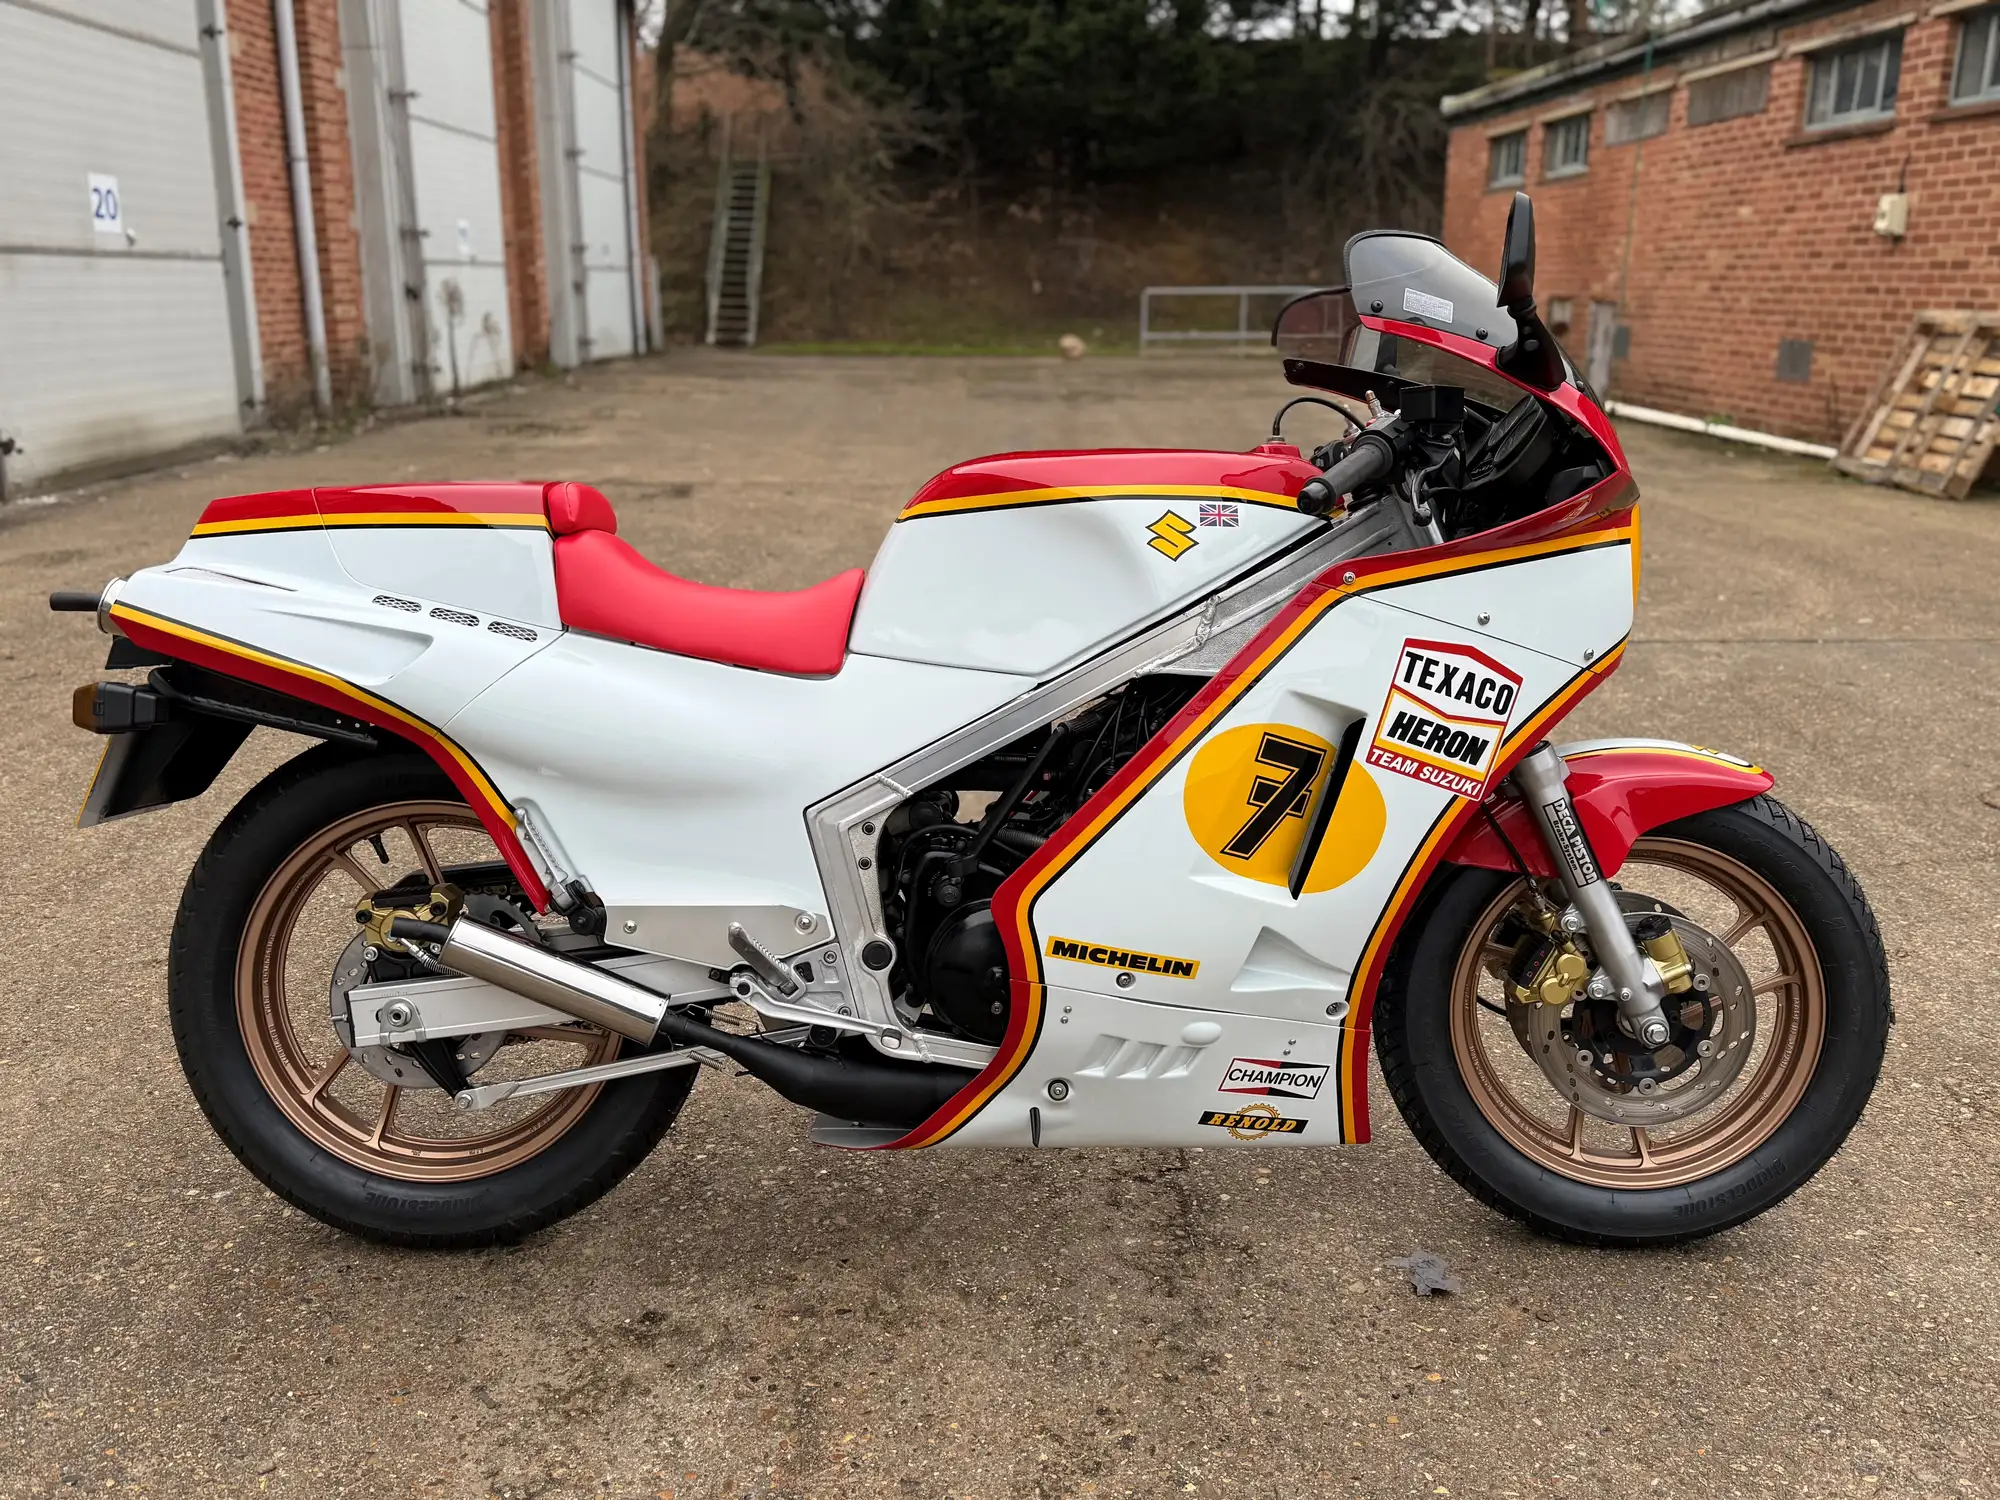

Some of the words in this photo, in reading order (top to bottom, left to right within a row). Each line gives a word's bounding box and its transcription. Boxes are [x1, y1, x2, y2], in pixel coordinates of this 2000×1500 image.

[92, 187, 119, 222] 20
[1403, 651, 1516, 717] TEXACO
[1387, 711, 1490, 767] HERON
[1370, 747, 1420, 779] TEAM
[1421, 765, 1482, 797] SUZUKI
[1219, 731, 1327, 861] 7
[1553, 798, 1577, 837] DECA
[1051, 940, 1195, 978] MICHELIN
[1228, 1067, 1323, 1089] CHAMPION
[1207, 1112, 1298, 1132] RENOLD
[1673, 1157, 1788, 1219] BRIDGESTONE
